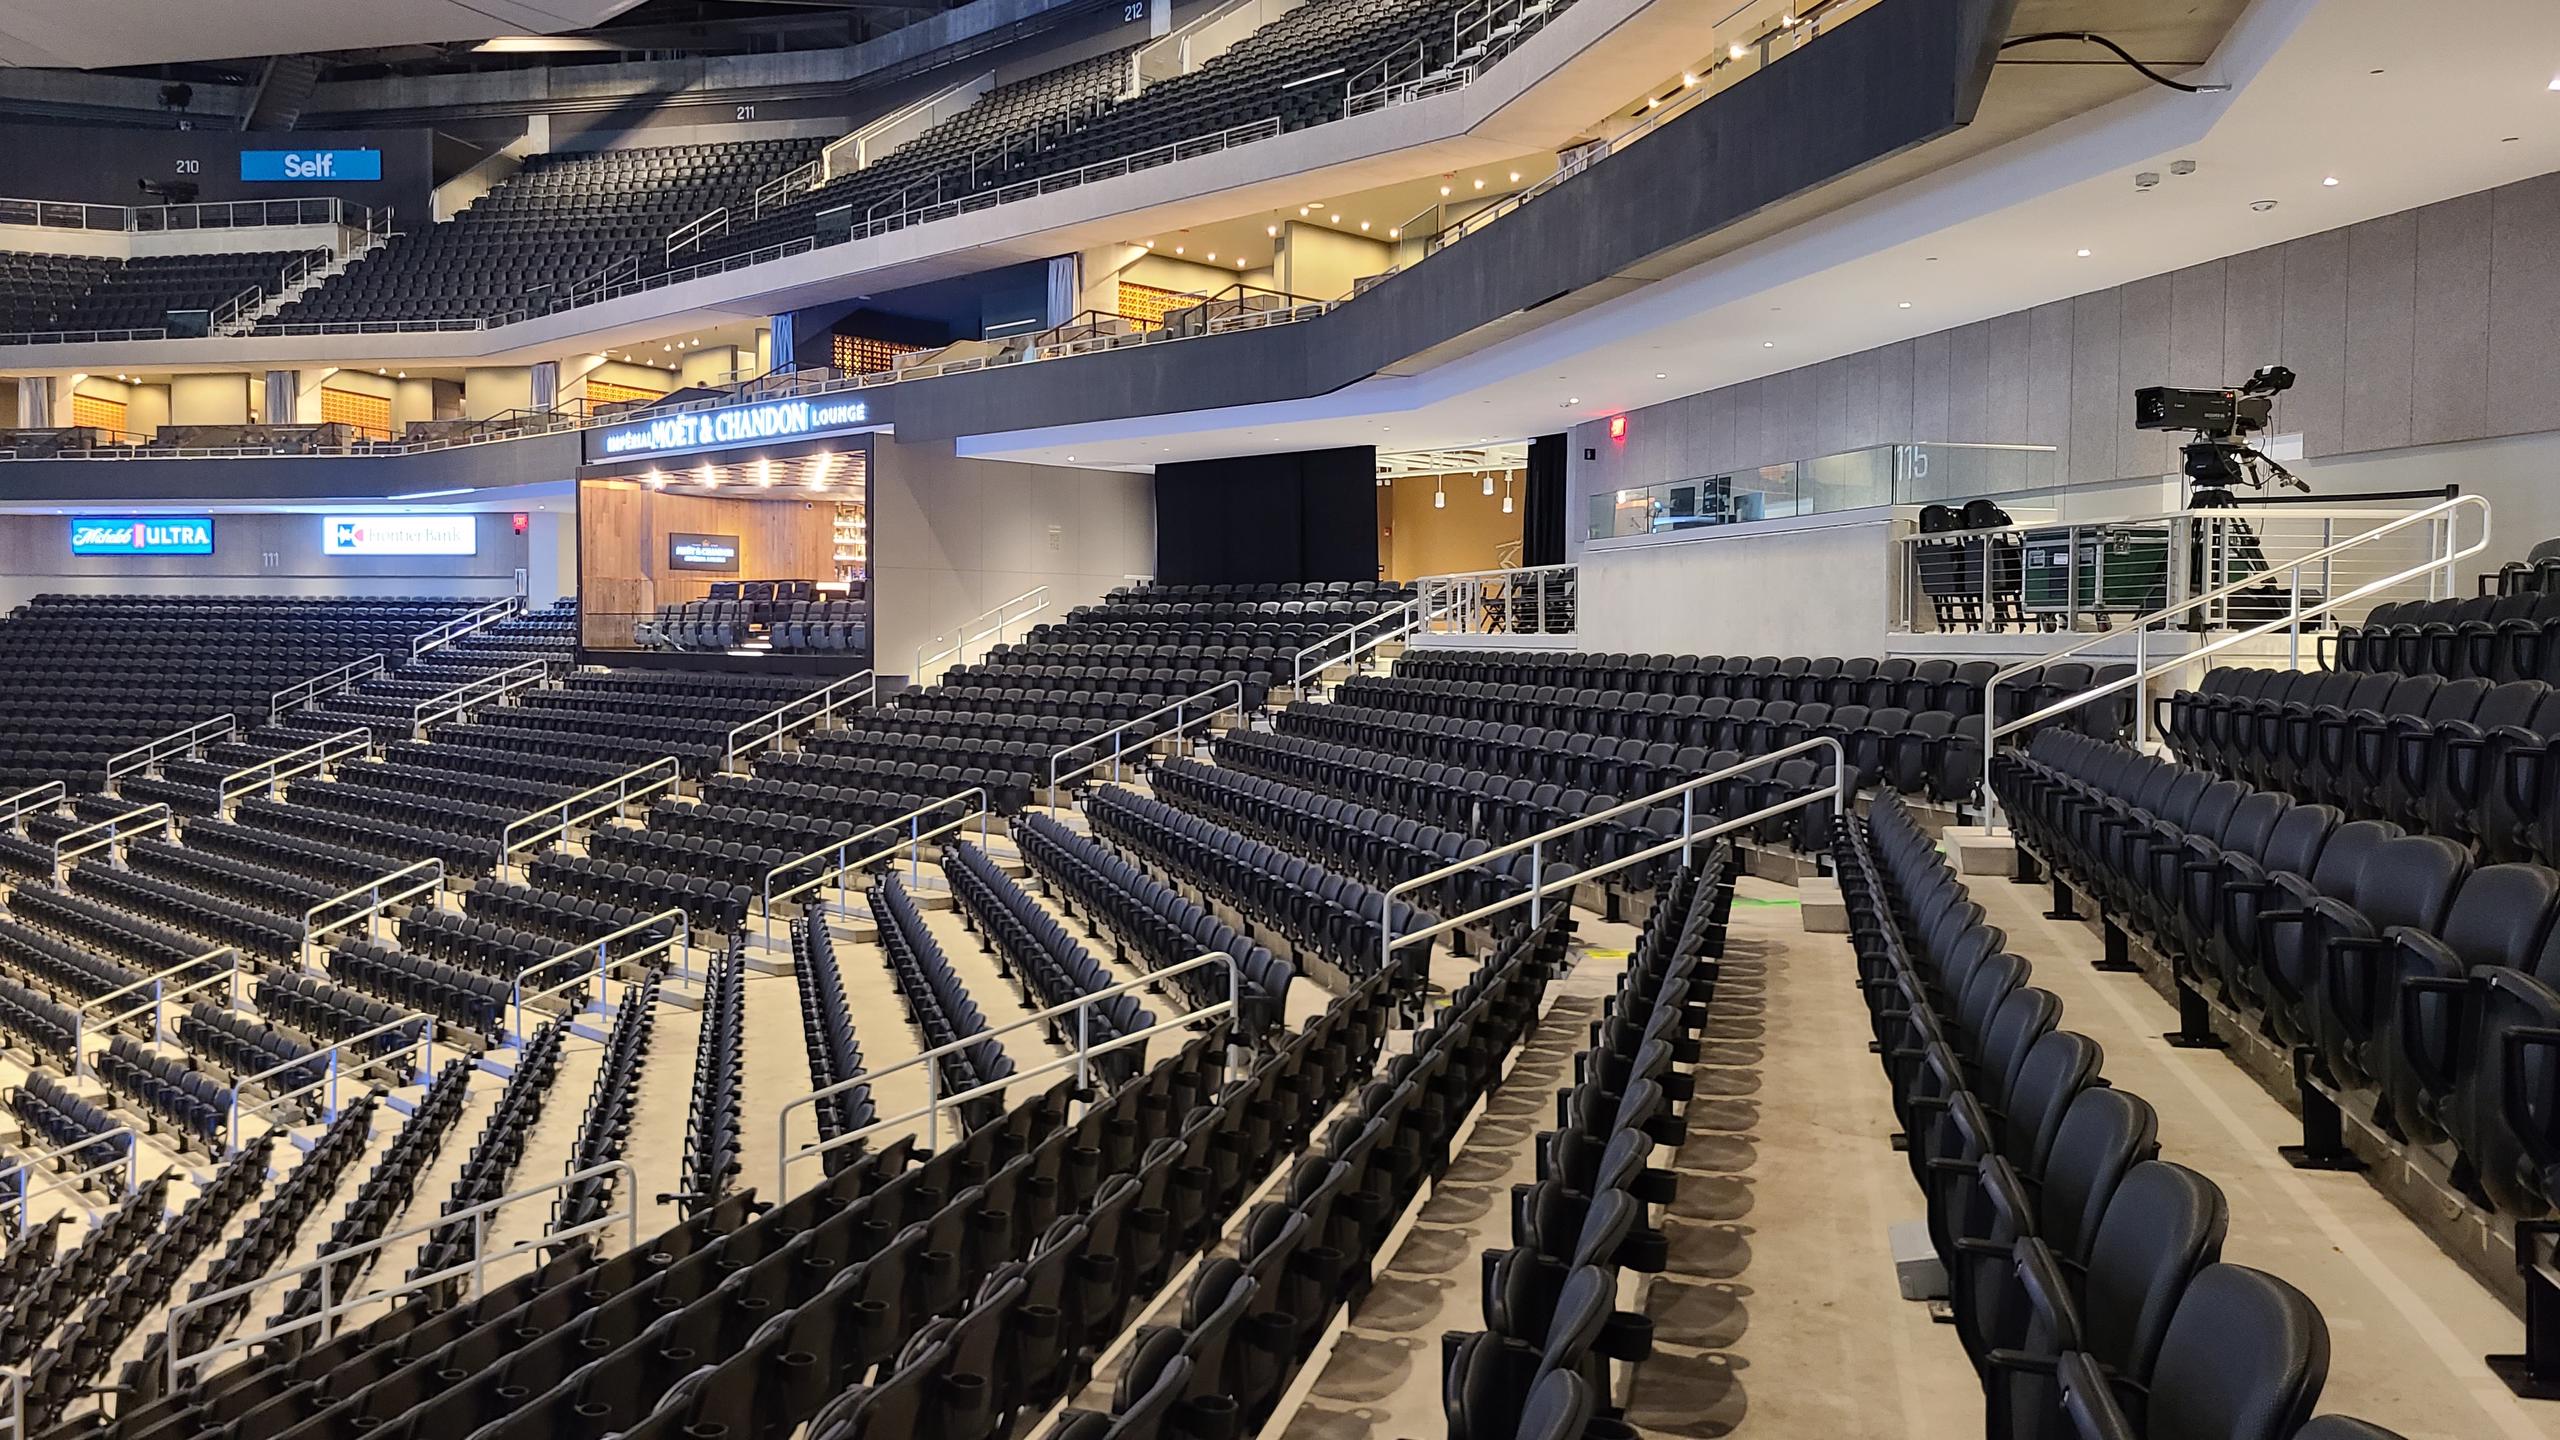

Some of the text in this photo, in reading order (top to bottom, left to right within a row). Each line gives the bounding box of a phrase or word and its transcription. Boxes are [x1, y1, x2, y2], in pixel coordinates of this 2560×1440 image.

[1124, 1, 1143, 22] 212
[736, 105, 755, 120] 211
[176, 160, 199, 174] 210
[650, 413, 698, 450] MOËT
[699, 414, 714, 444] &
[715, 401, 810, 442] CHANDON
[812, 402, 866, 427] LOUNGE
[1896, 445, 1928, 481] 115
[146, 526, 210, 545] ULTRA
[263, 551, 279, 567] 111
